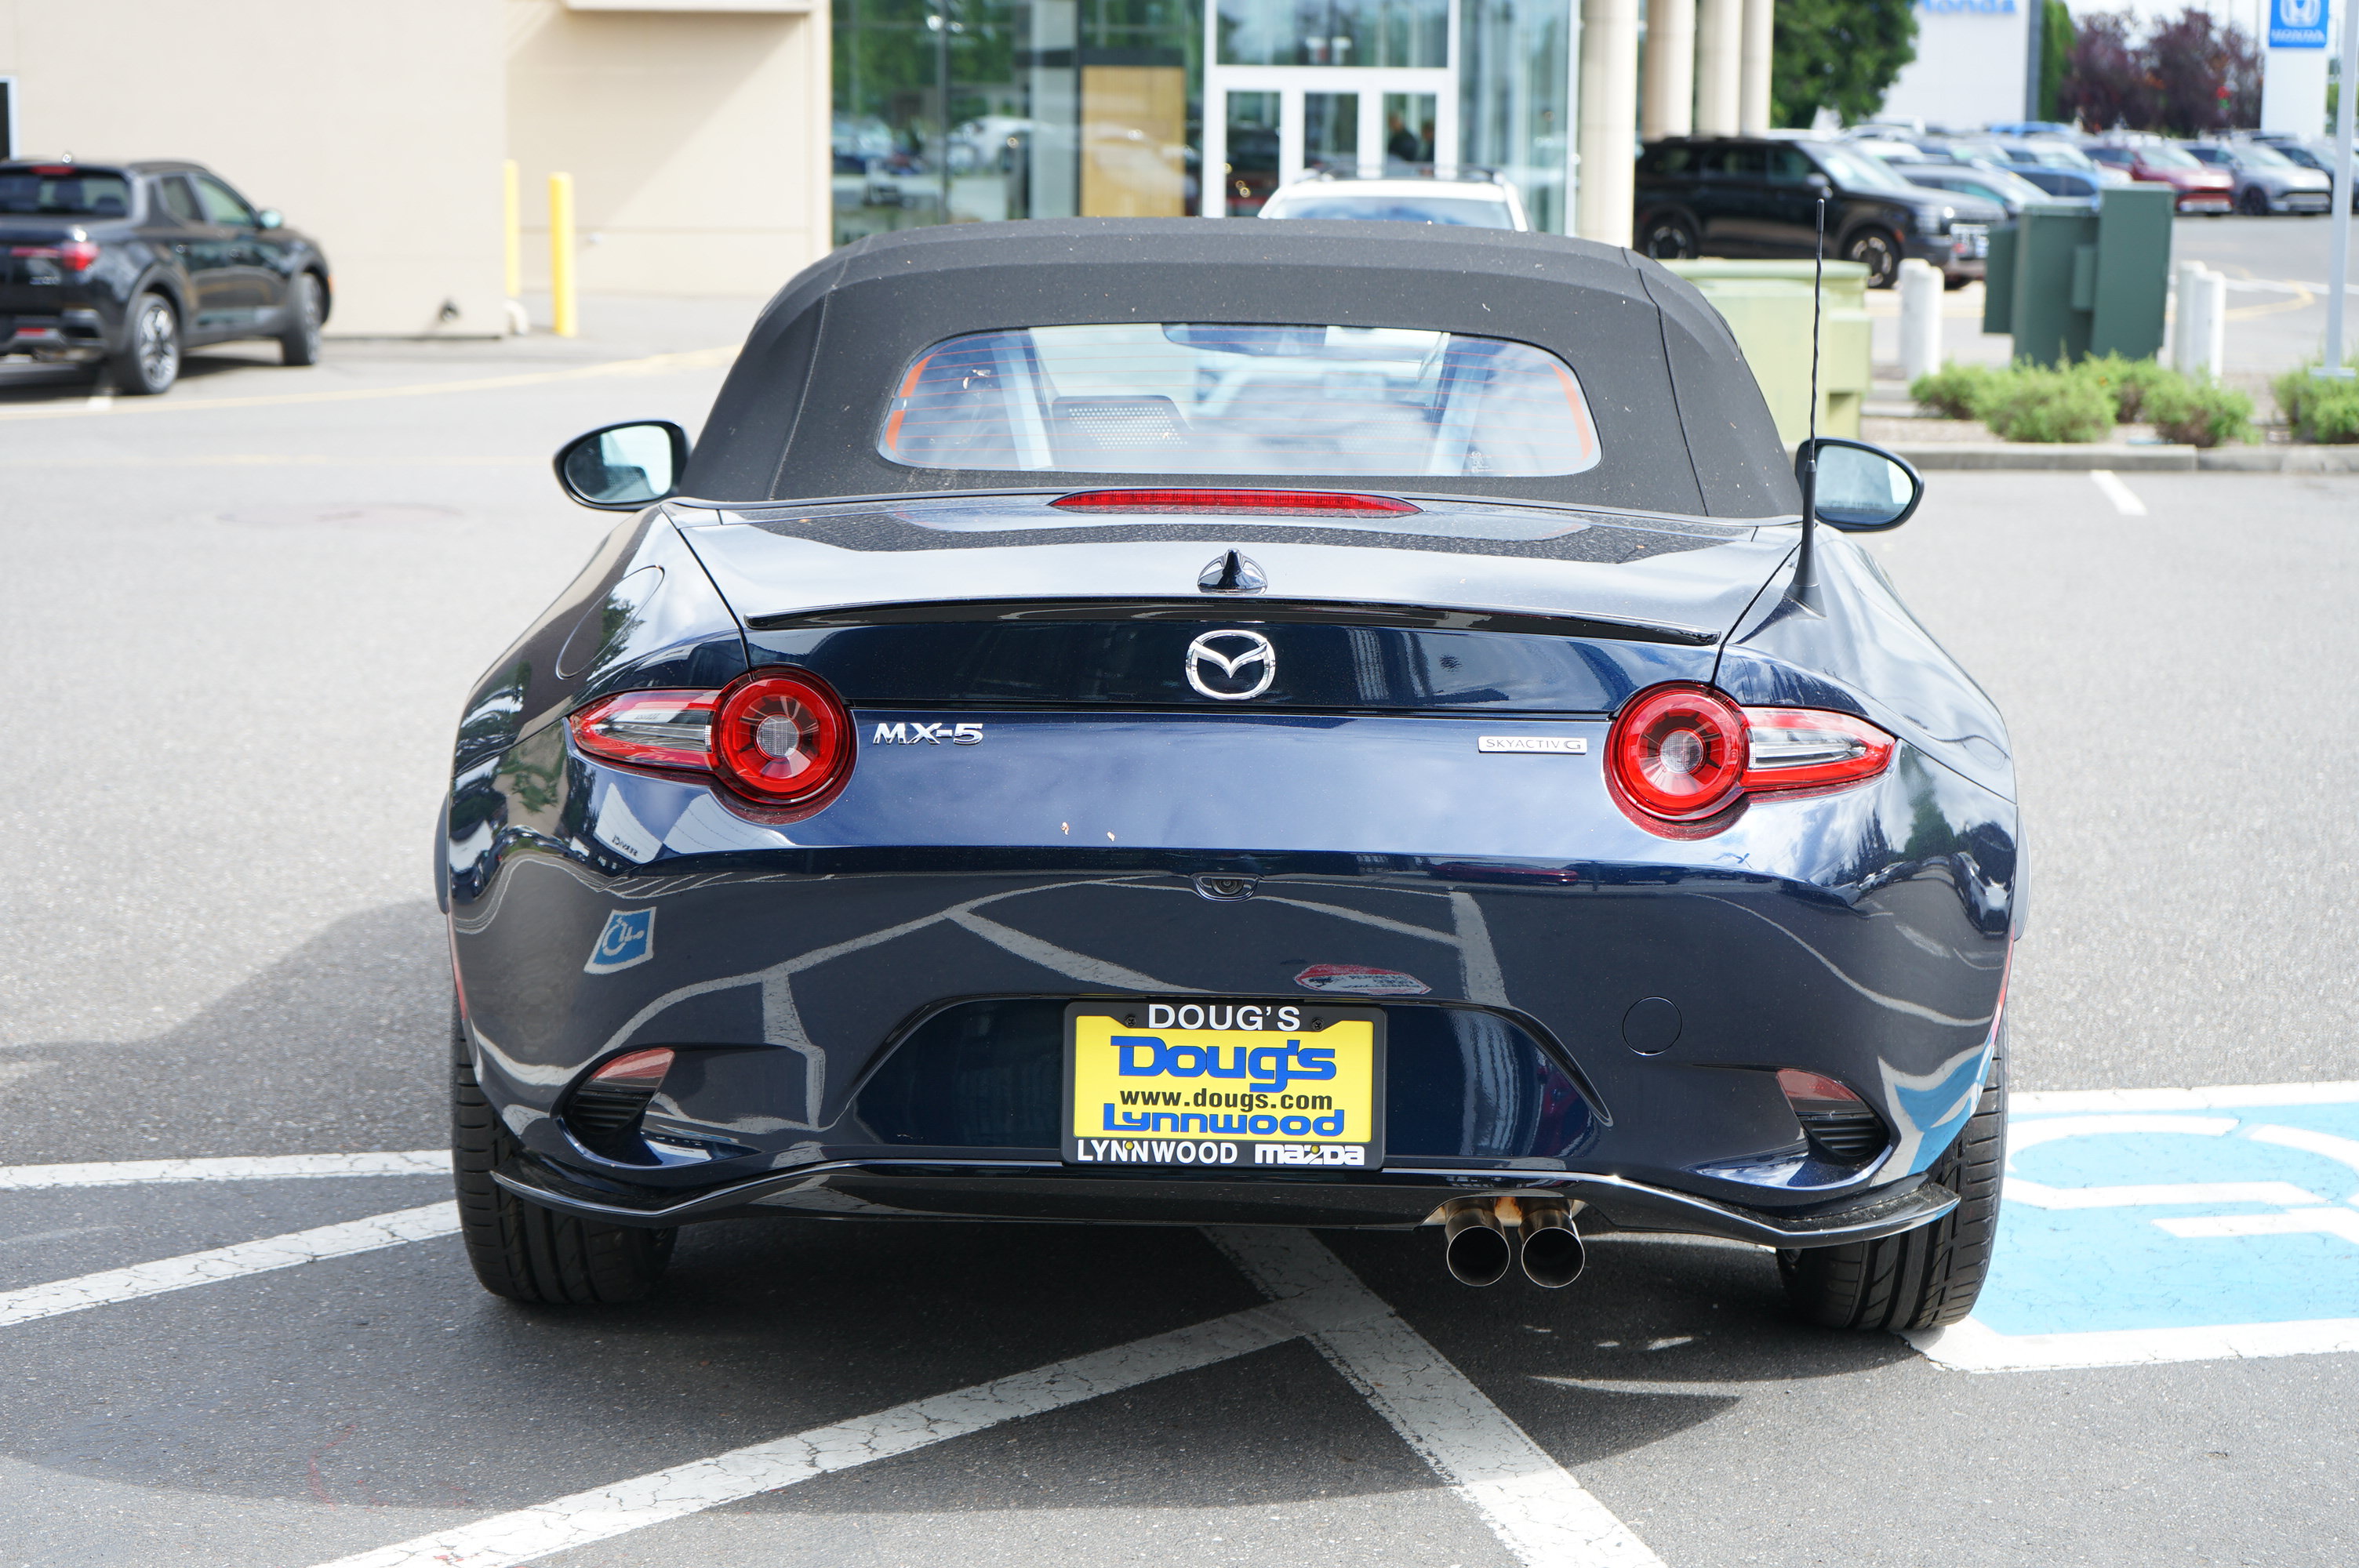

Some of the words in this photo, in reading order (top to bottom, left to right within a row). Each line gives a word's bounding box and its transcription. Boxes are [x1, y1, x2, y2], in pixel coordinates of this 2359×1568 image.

[873, 723, 983, 745] MX-5
[1486, 739, 1560, 749] SKYACTIV
[1564, 740, 1581, 750] G
[1148, 1004, 1300, 1031] DOUG'S
[1110, 1036, 1336, 1093] Doug's
[1120, 1088, 1332, 1112] www.dougs.com
[1103, 1103, 1344, 1137] Lynnwood
[1077, 1139, 1238, 1164] LYNNWOOD
